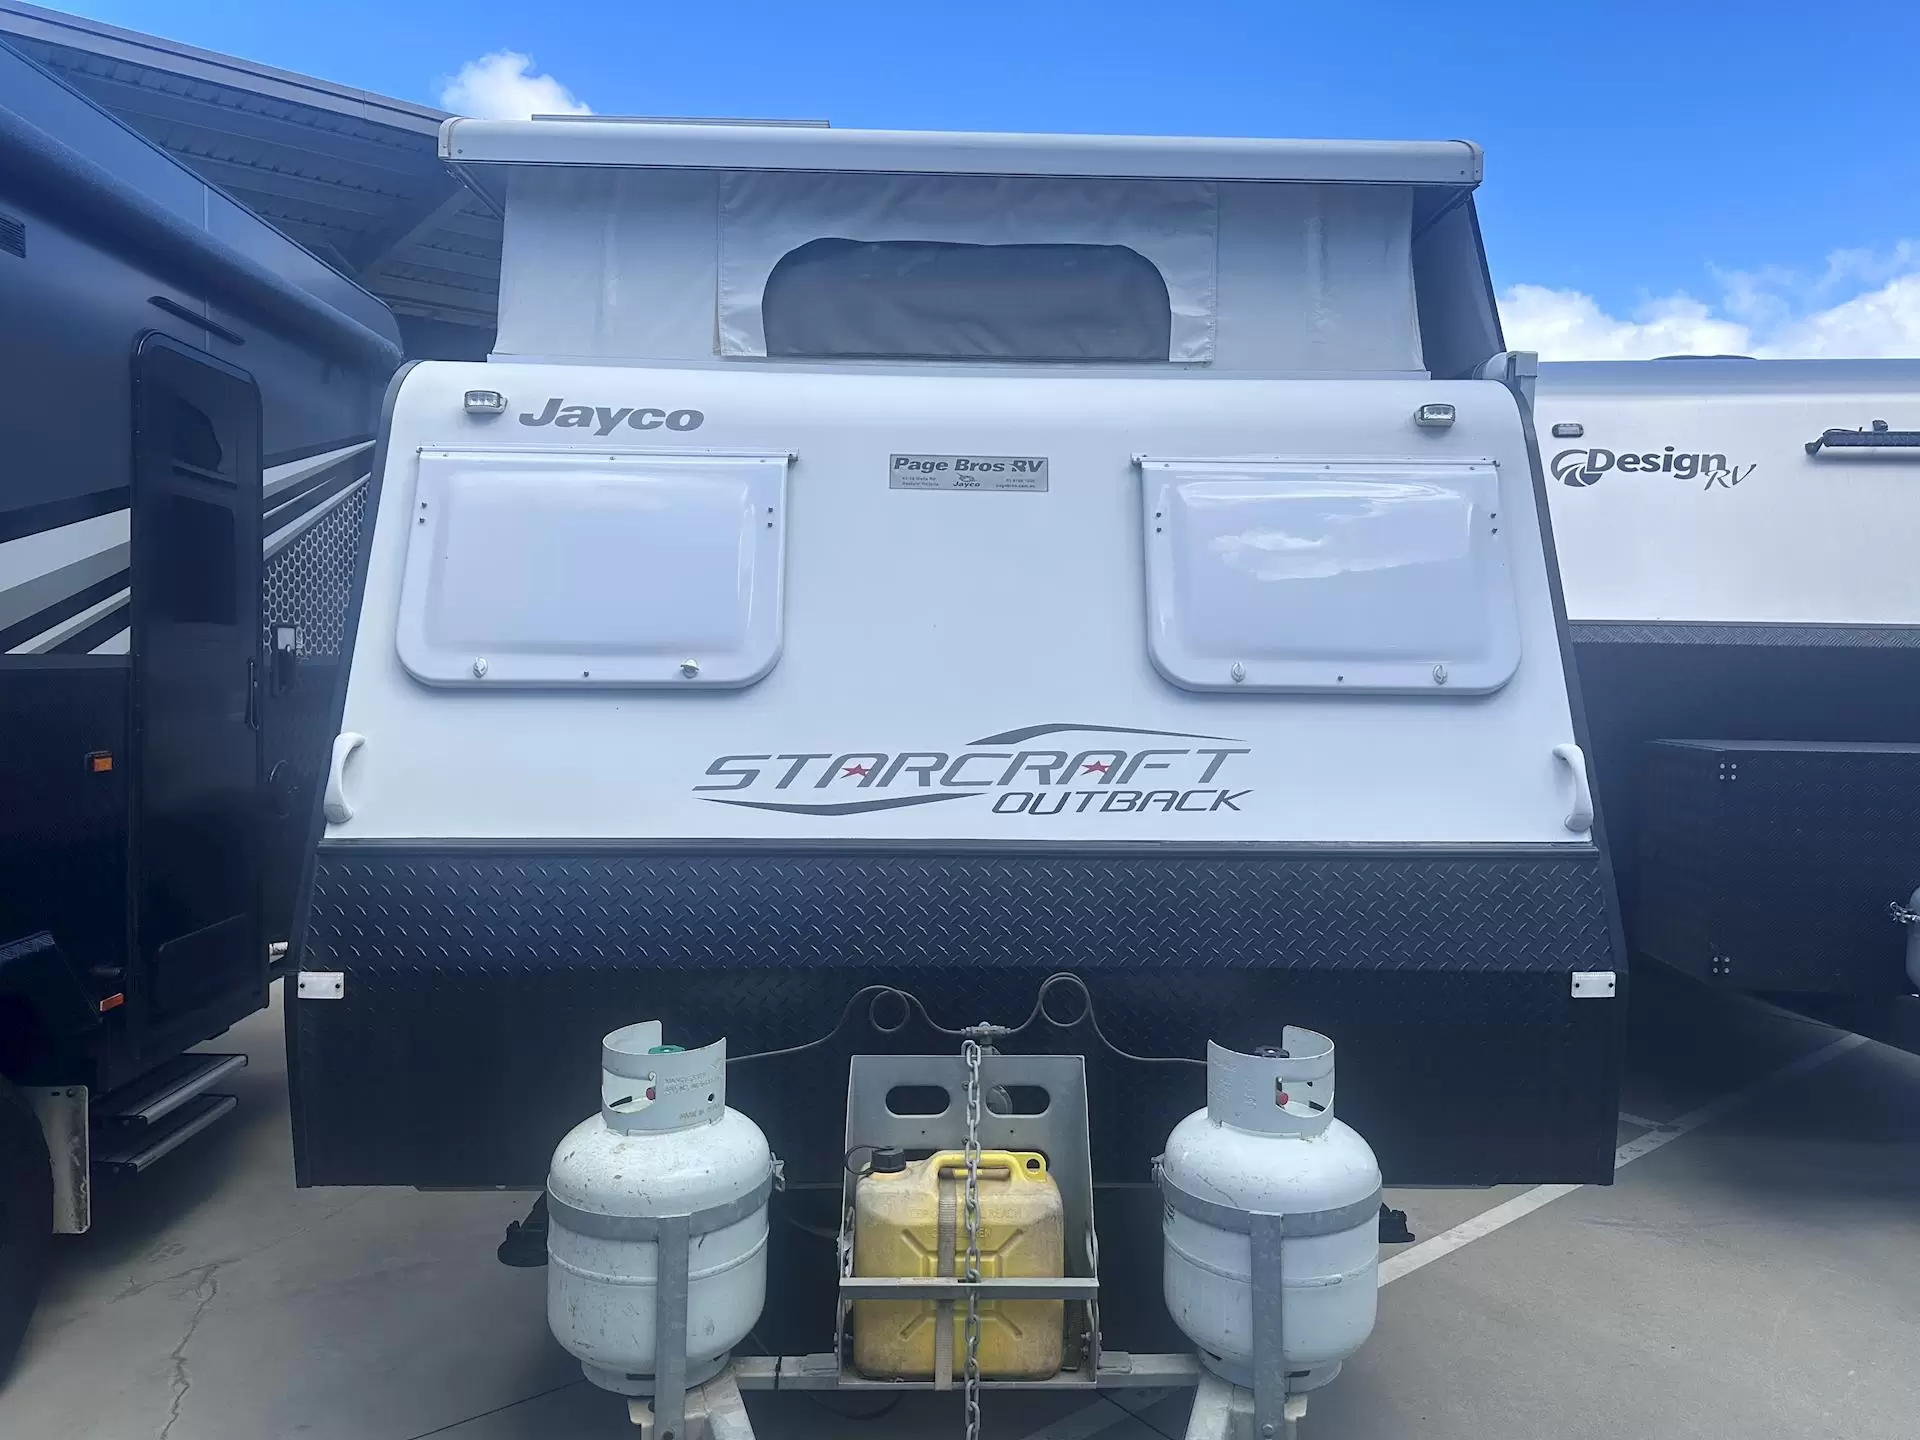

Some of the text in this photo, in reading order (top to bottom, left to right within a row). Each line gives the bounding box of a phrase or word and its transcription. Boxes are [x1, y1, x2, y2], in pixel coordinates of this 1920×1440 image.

[519, 398, 705, 436] Jayco
[894, 457, 1044, 474] Page Bros RV
[1586, 446, 1727, 480] Design
[1704, 464, 1757, 490] RV
[692, 749, 1252, 791] STARCRAFT
[991, 789, 1255, 815] OUTBACK
